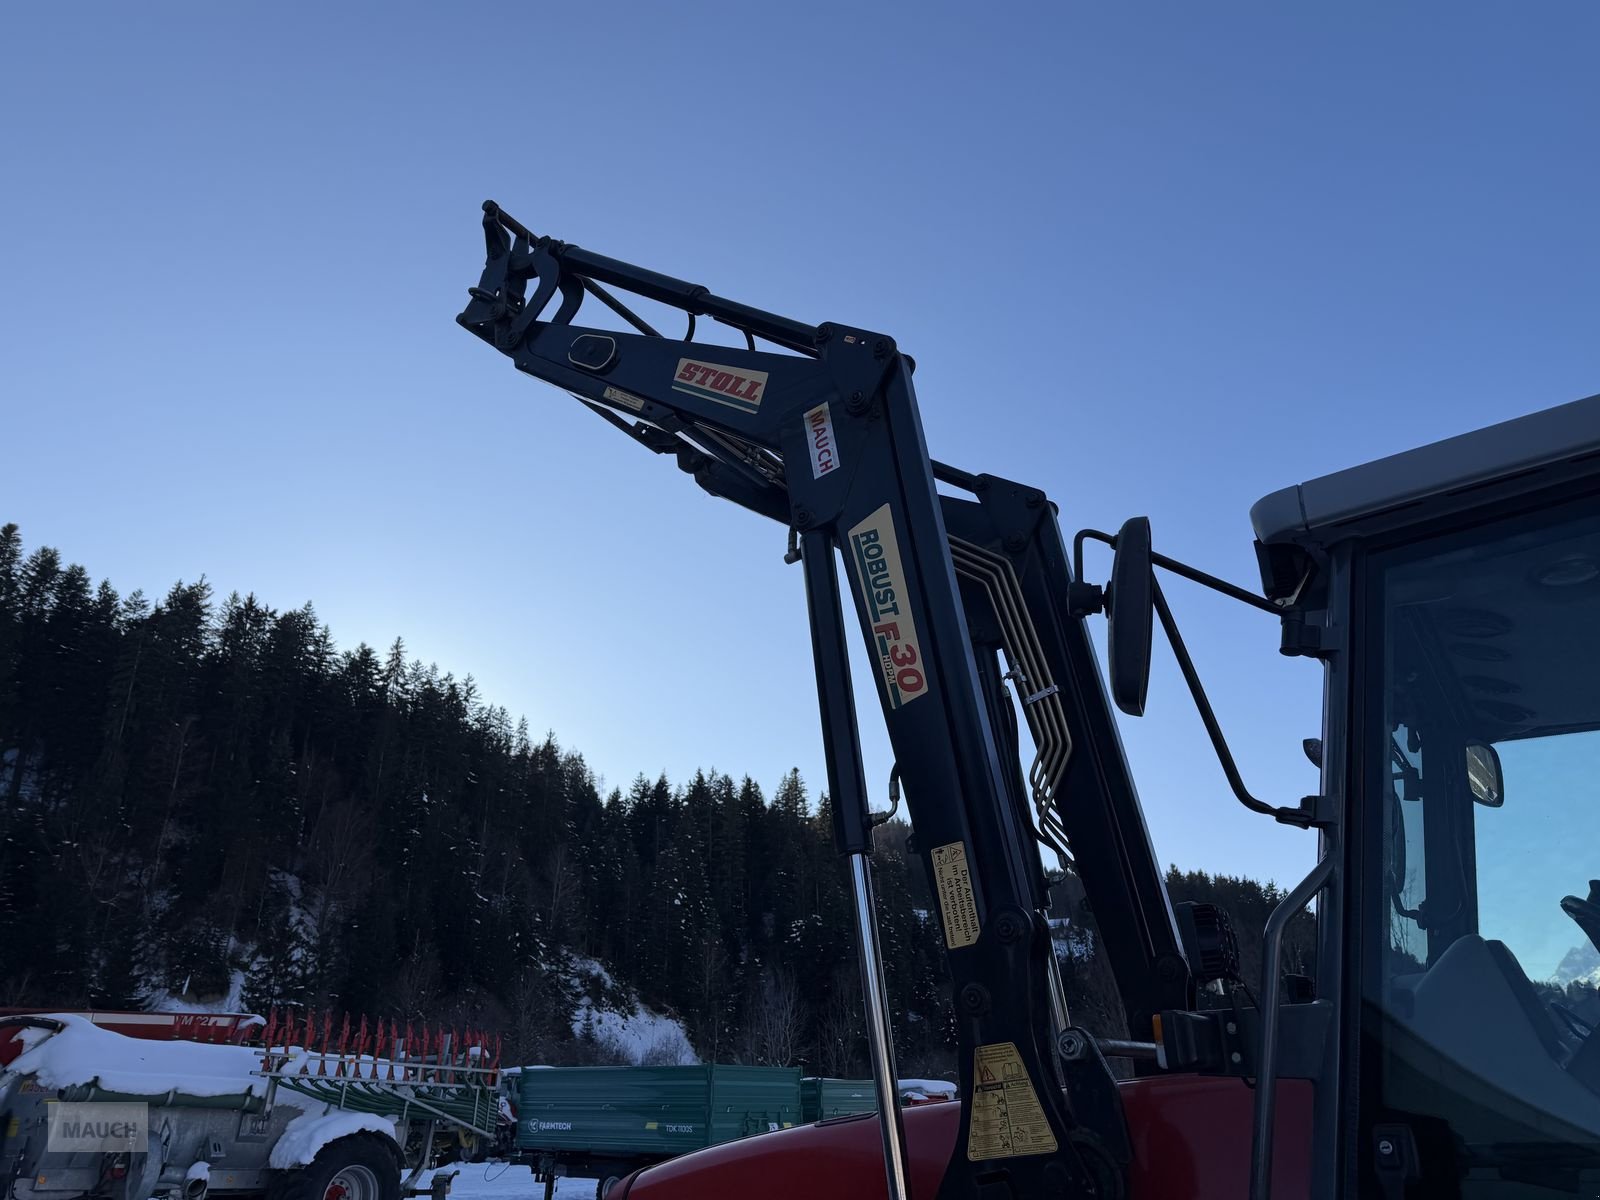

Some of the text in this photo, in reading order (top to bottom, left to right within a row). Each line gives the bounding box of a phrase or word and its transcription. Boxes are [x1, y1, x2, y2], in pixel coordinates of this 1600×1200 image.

[677, 362, 762, 402] STOLL
[809, 409, 834, 474] MAUCH
[859, 528, 900, 616] ROBUST
[882, 654, 895, 684] HDPM
[946, 877, 962, 932] ist verboten!
[951, 864, 972, 942] im Arbeitsbereich
[961, 869, 979, 933] Der Aufenthalt
[539, 1121, 572, 1131] FARMTECH
